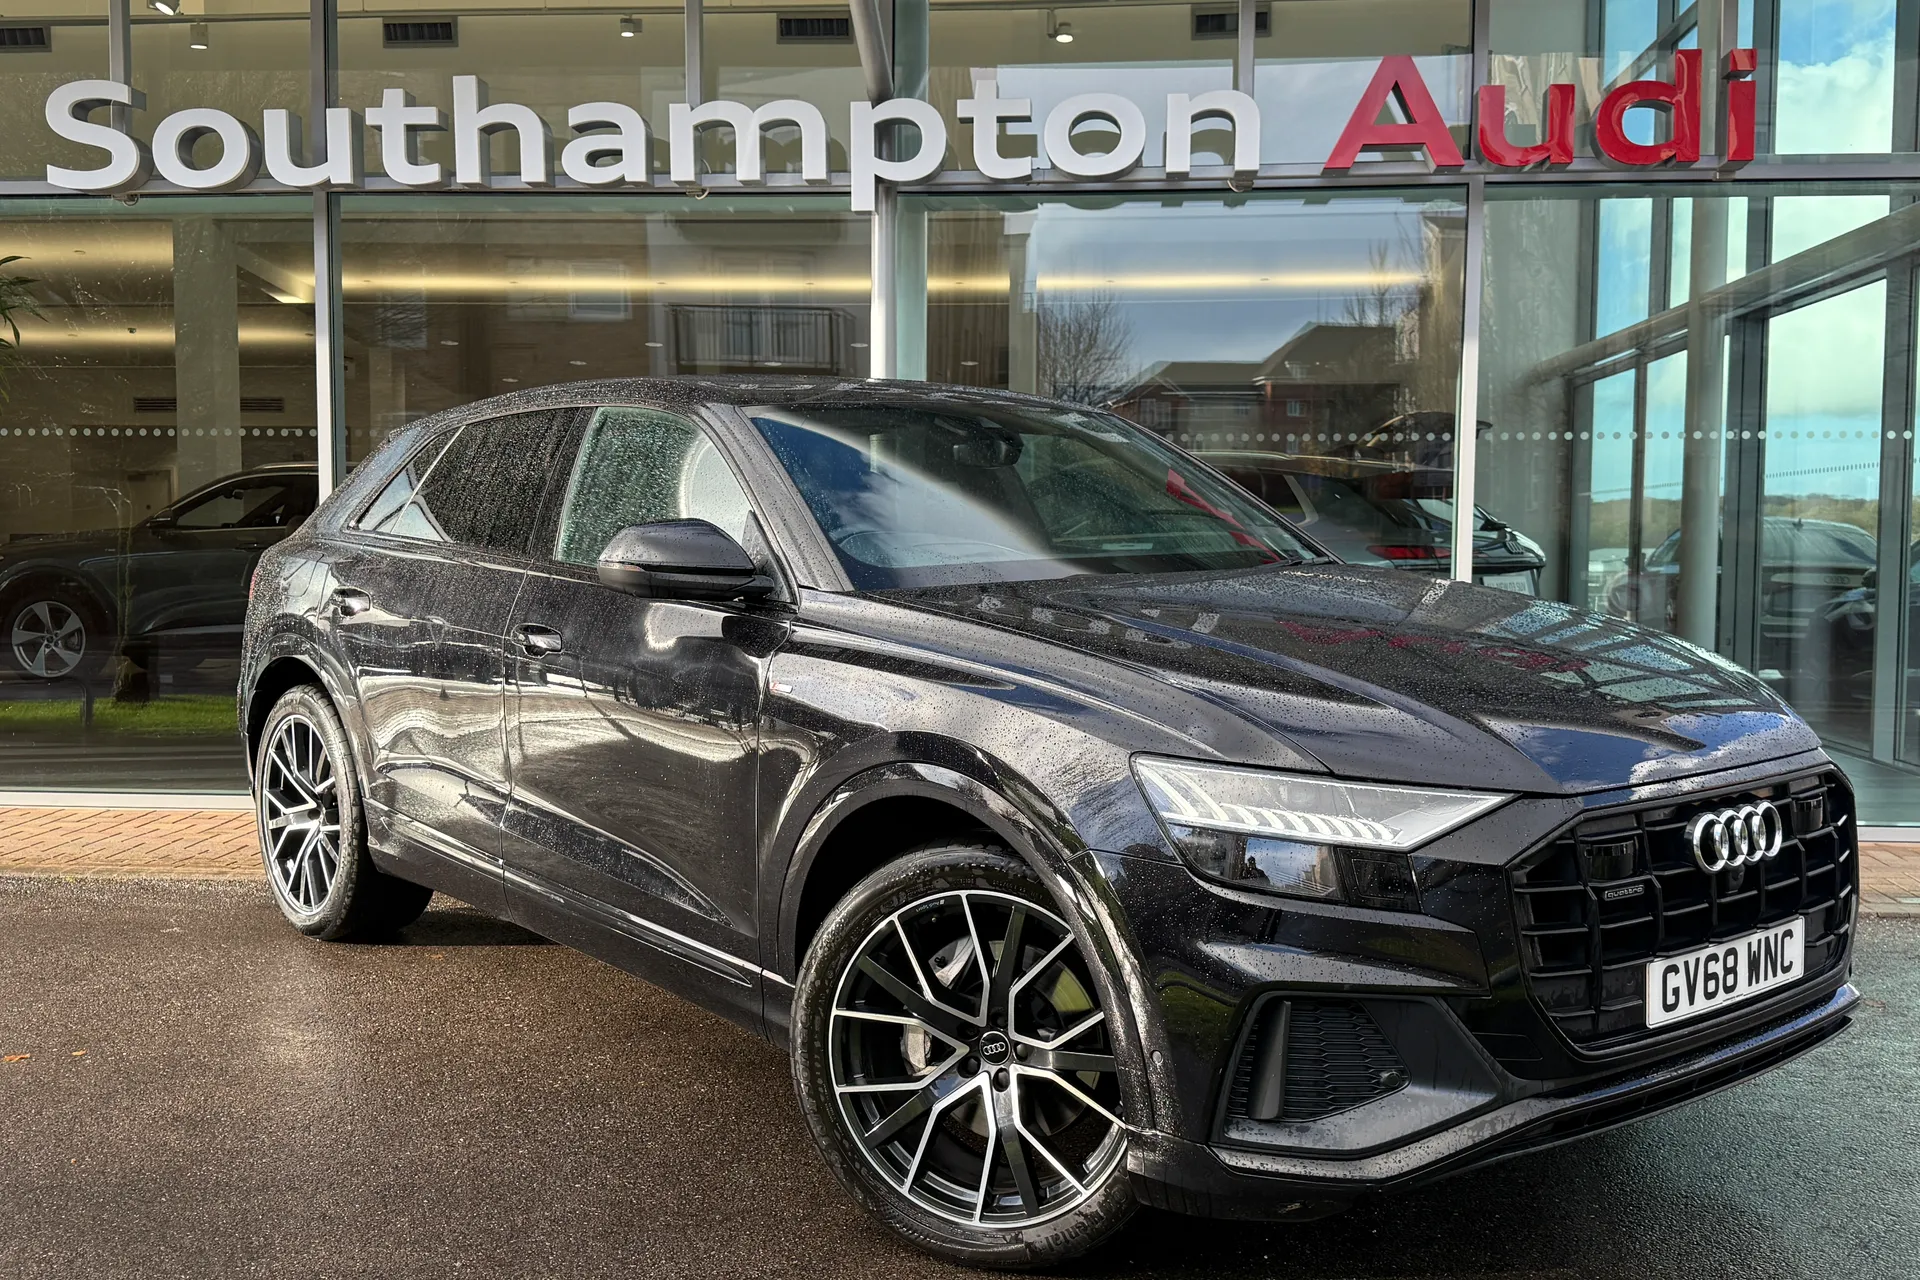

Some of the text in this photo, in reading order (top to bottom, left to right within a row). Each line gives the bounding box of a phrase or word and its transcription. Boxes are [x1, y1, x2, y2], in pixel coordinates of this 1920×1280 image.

[45, 48, 1758, 213] Southampton Audi
[1607, 886, 1643, 899] quattro
[1661, 928, 1794, 1014] GV68 WNC
